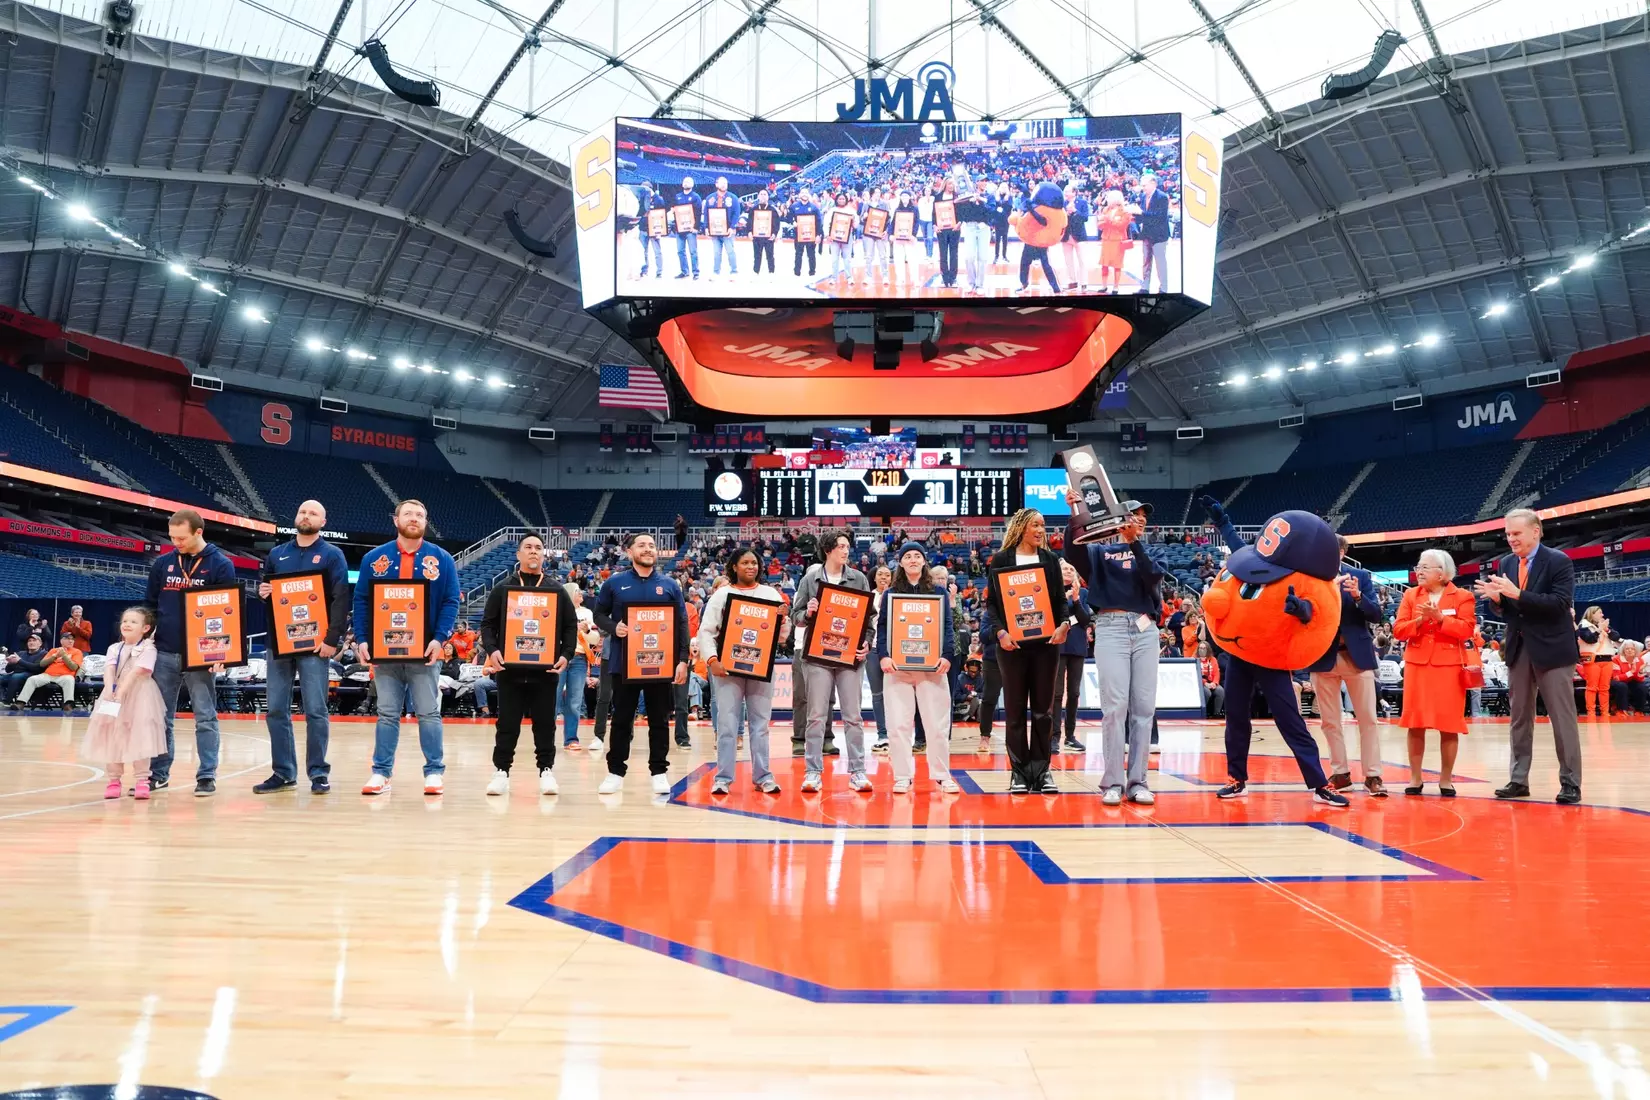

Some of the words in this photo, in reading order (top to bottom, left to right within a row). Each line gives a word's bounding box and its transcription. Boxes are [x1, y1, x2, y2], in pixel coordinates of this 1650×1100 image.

[837, 77, 956, 121] JMA
[574, 134, 613, 232] S
[1183, 130, 1219, 228] S
[723, 342, 834, 371] JMA
[933, 340, 1041, 371] JMA
[260, 402, 293, 446] S
[1457, 400, 1517, 429] JMA
[331, 425, 416, 452] SYRACUSE
[743, 431, 764, 443] 44
[871, 470, 900, 487] 12:10
[828, 481, 846, 505] 41
[924, 481, 945, 505] 30
[724, 504, 748, 512] WEBB
[9, 521, 25, 532] ROY
[26, 524, 61, 537] SIMMONS
[62, 529, 72, 539] JR
[79, 533, 94, 542] DICK
[95, 536, 135, 549] MacPHERSON
[1257, 517, 1290, 557] S
